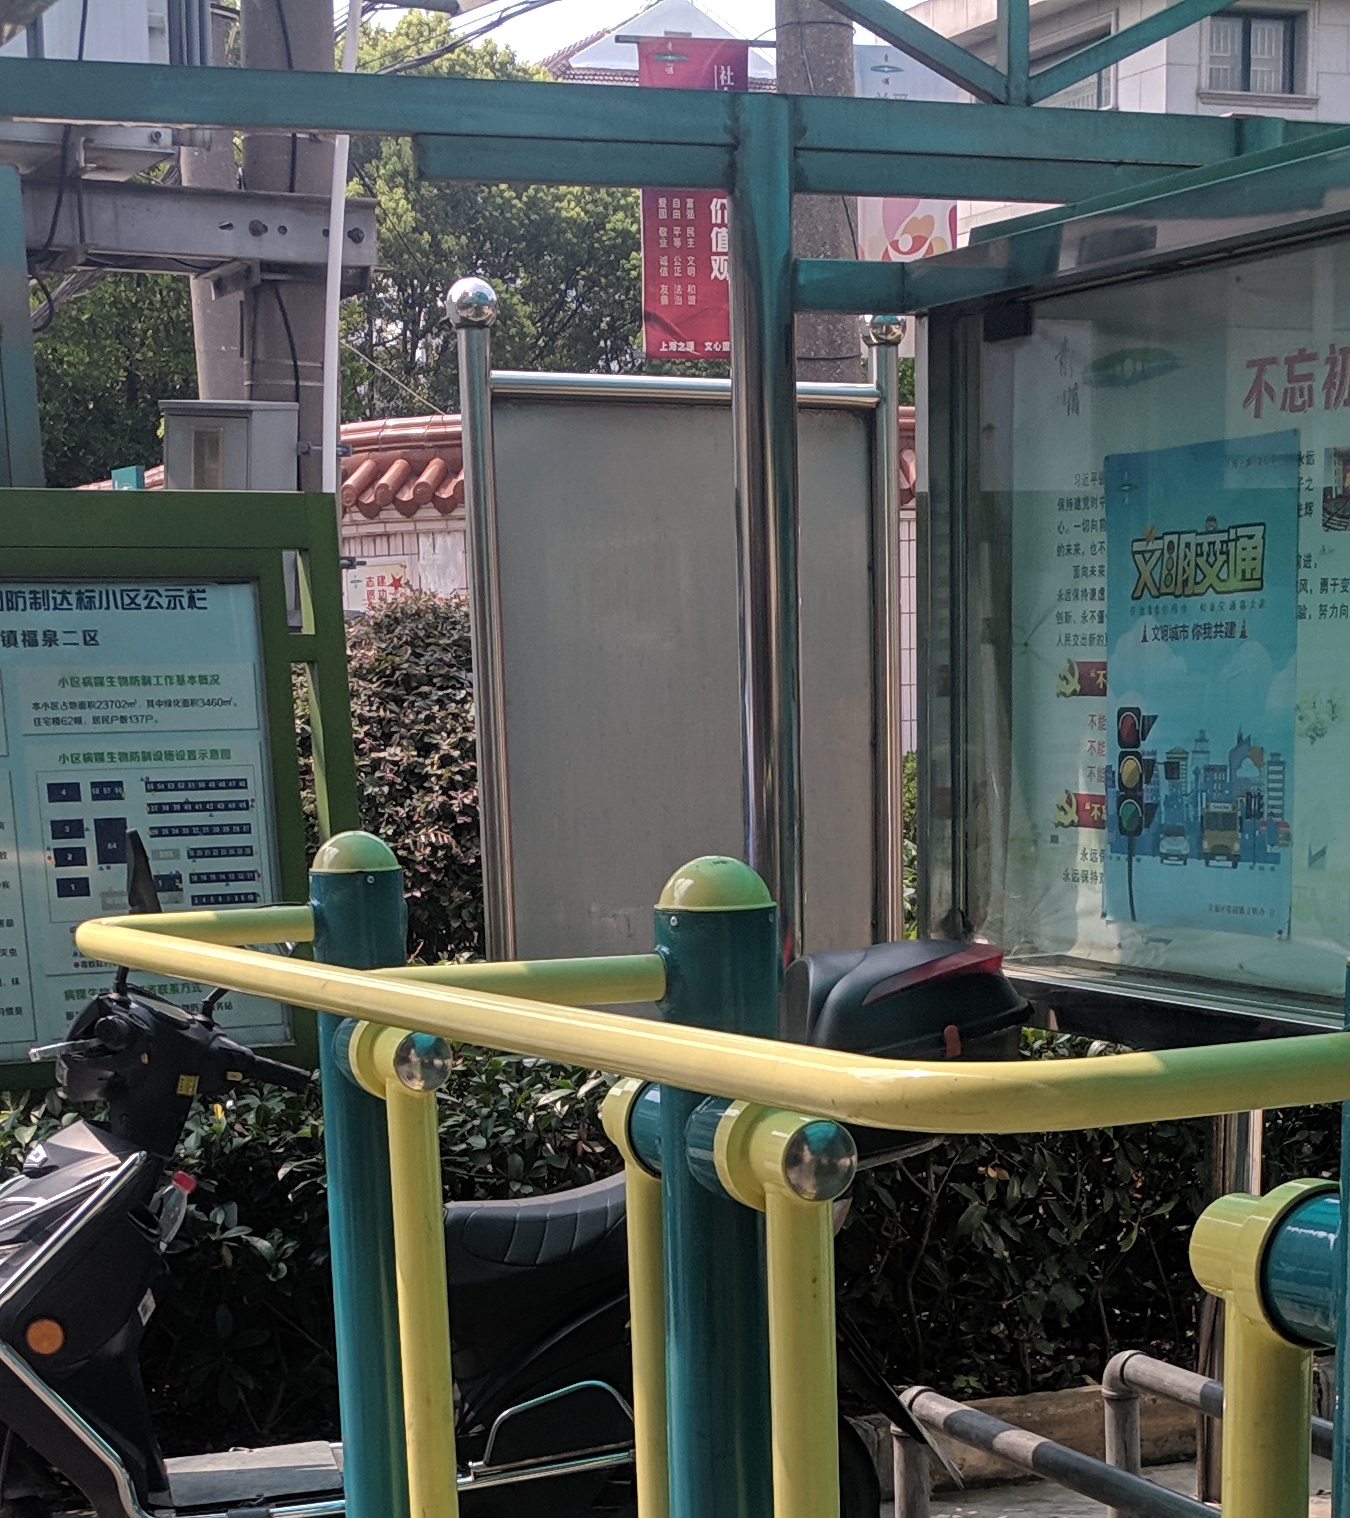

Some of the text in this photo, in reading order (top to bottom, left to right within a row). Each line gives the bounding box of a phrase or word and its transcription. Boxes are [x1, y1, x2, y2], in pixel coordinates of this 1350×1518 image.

[1130, 522, 1266, 600] 文明交通
[1152, 620, 1237, 642] 文明城市 你我共建
